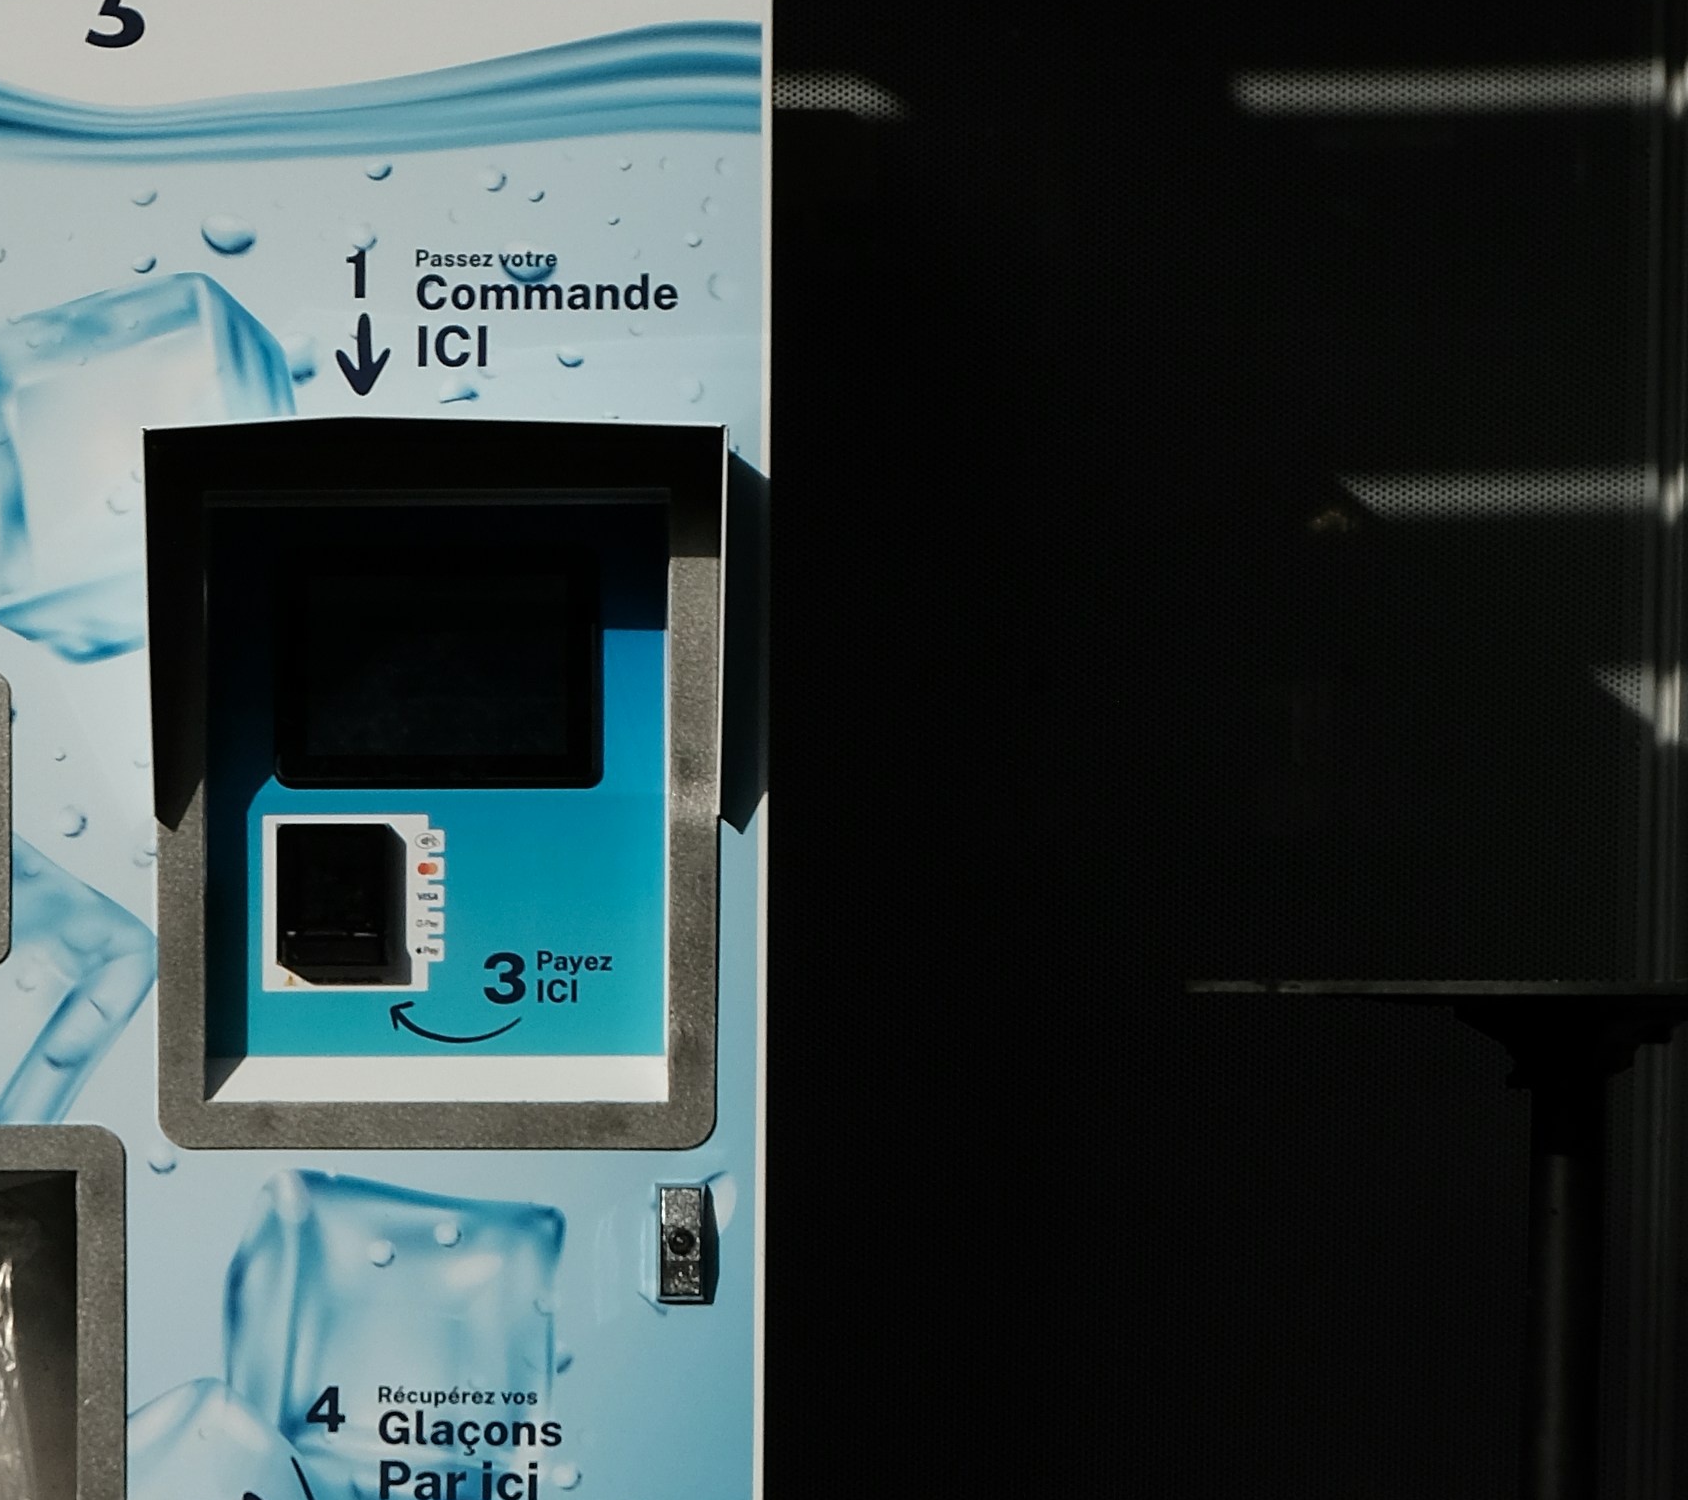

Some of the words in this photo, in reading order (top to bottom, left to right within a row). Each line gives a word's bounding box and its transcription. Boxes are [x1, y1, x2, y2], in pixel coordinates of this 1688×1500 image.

[345, 251, 366, 299] 1
[415, 249, 493, 268] Passez
[498, 251, 558, 269] votre
[416, 271, 679, 311] Commande
[417, 325, 488, 368] ICI
[483, 952, 526, 1005] 3
[537, 950, 613, 975] Payez
[537, 978, 578, 1004] ICI
[306, 1386, 346, 1433] 4
[378, 1386, 496, 1408] Récupérez
[501, 1391, 538, 1406] vos
[378, 1409, 562, 1456] Glaçons
